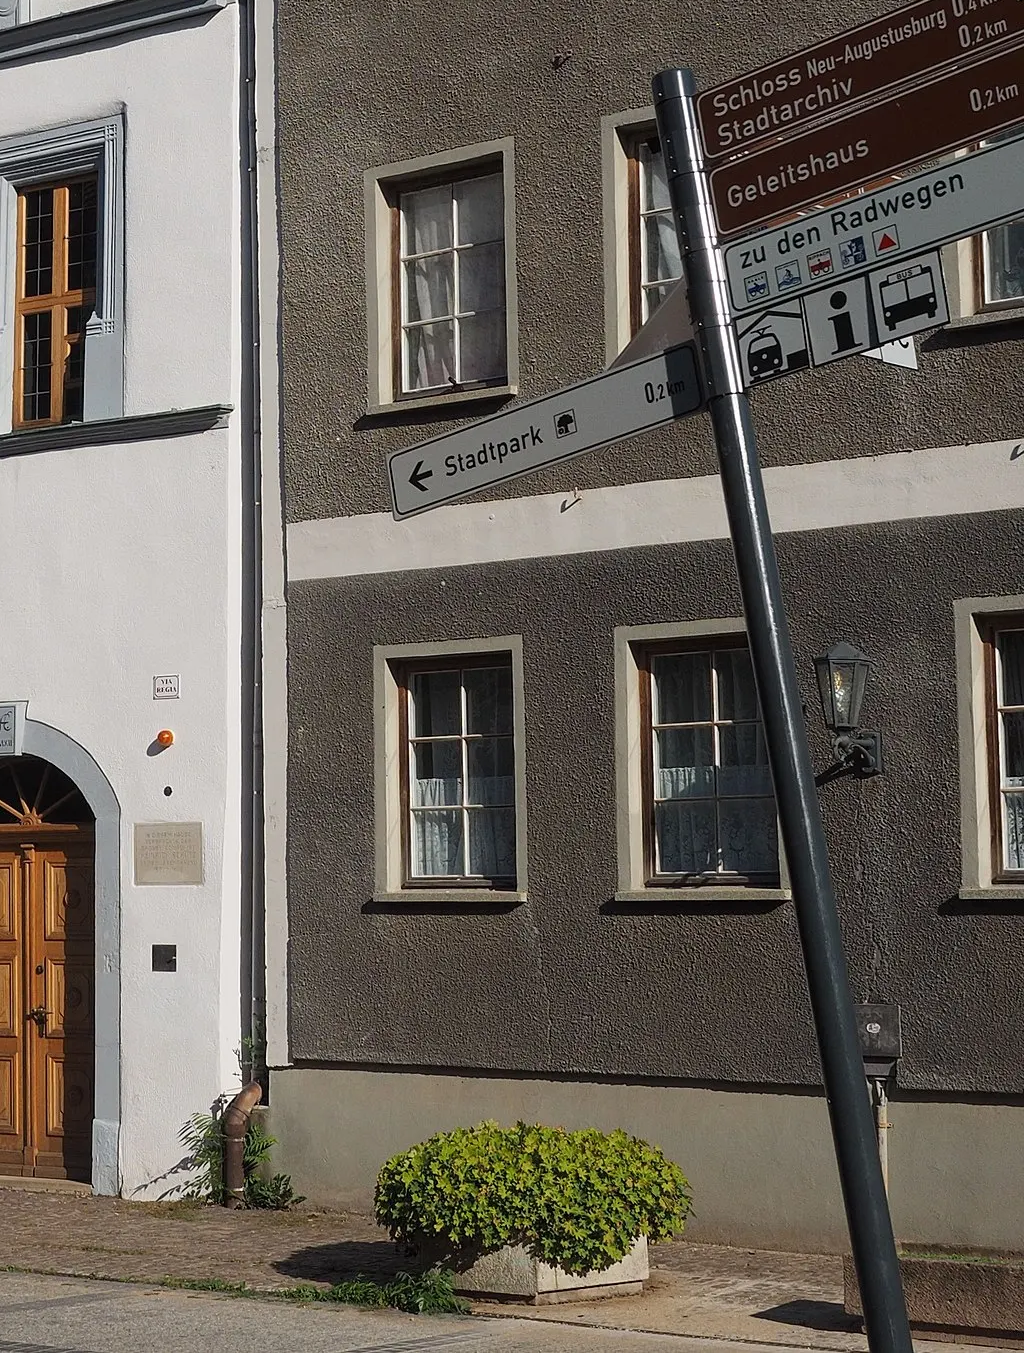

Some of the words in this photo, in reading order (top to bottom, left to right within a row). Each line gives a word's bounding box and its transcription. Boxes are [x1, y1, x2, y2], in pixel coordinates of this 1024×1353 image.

[712, 67, 802, 117] Schloss
[806, 8, 947, 79] Neu-Augustusburg
[717, 77, 853, 146] Stadtarchiv
[984, 19, 1008, 39] km
[727, 138, 869, 207] Geleitshaus
[995, 84, 1019, 103] km
[739, 245, 767, 270] zu
[776, 225, 821, 255] den
[830, 173, 965, 236] Radwegen
[896, 269, 914, 280] BUS
[444, 425, 544, 477] Stadtpark
[665, 380, 685, 397] km
